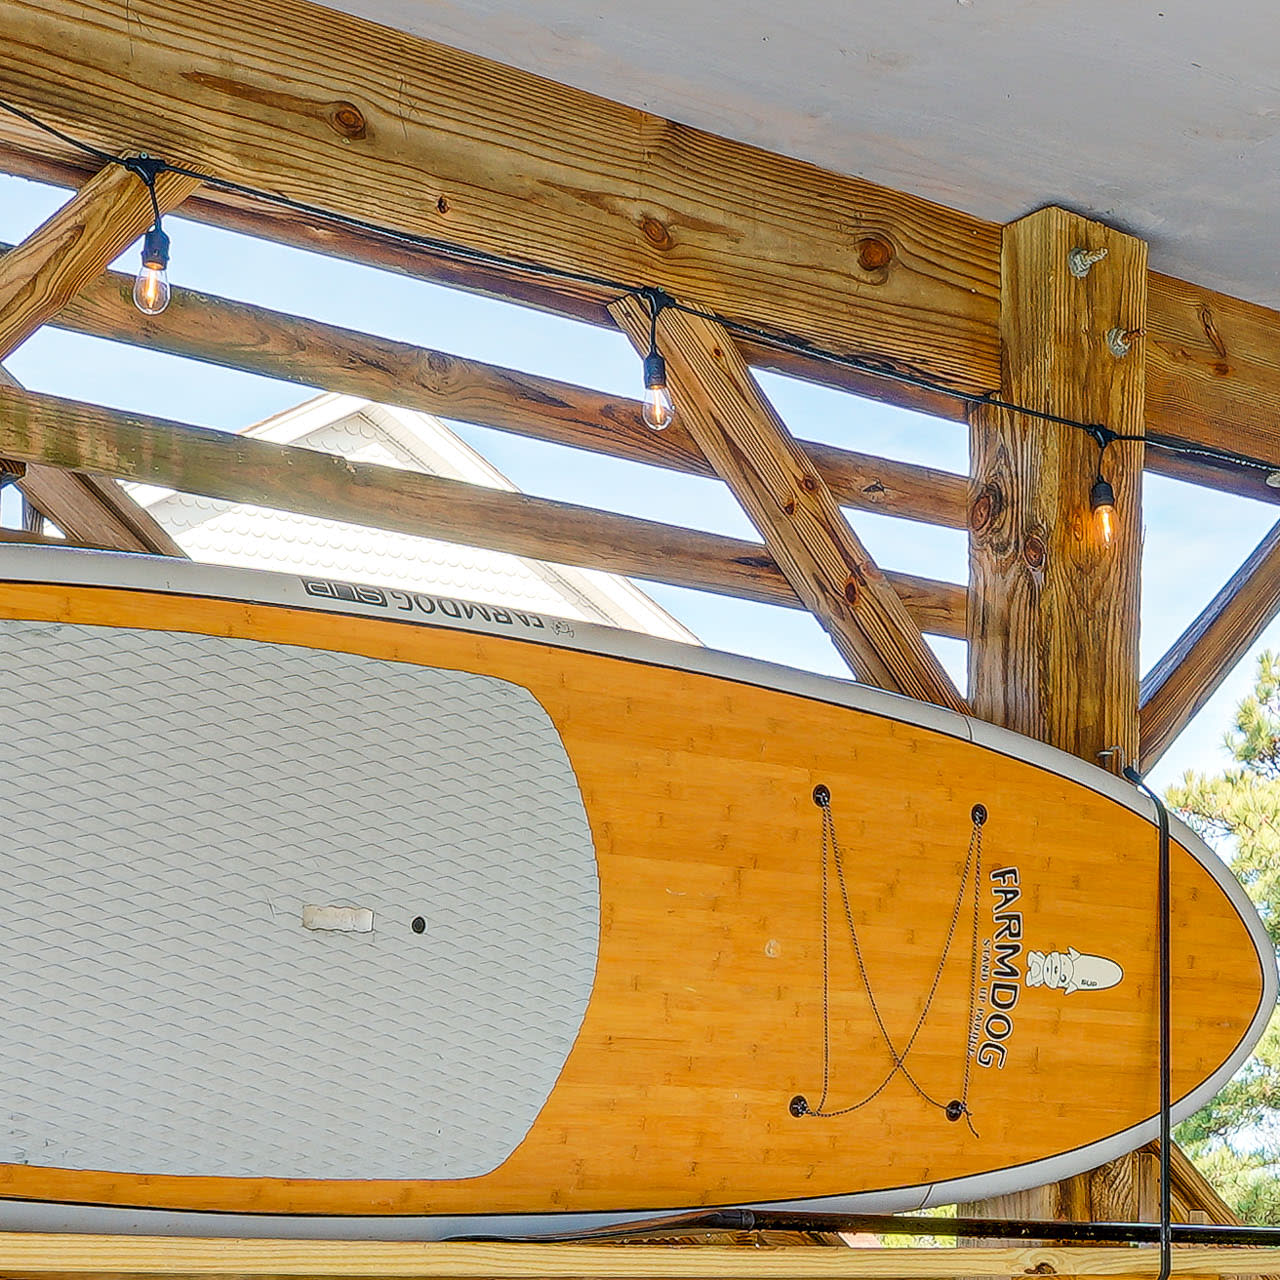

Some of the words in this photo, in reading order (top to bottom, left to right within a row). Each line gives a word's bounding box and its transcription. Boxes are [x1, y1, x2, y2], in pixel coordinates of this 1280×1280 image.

[304, 578, 385, 606] SUP
[390, 590, 544, 628] FARMDOG
[978, 867, 1022, 1069] FARMDOG
[980, 939, 991, 983] STAND
[978, 987, 988, 1003] UP
